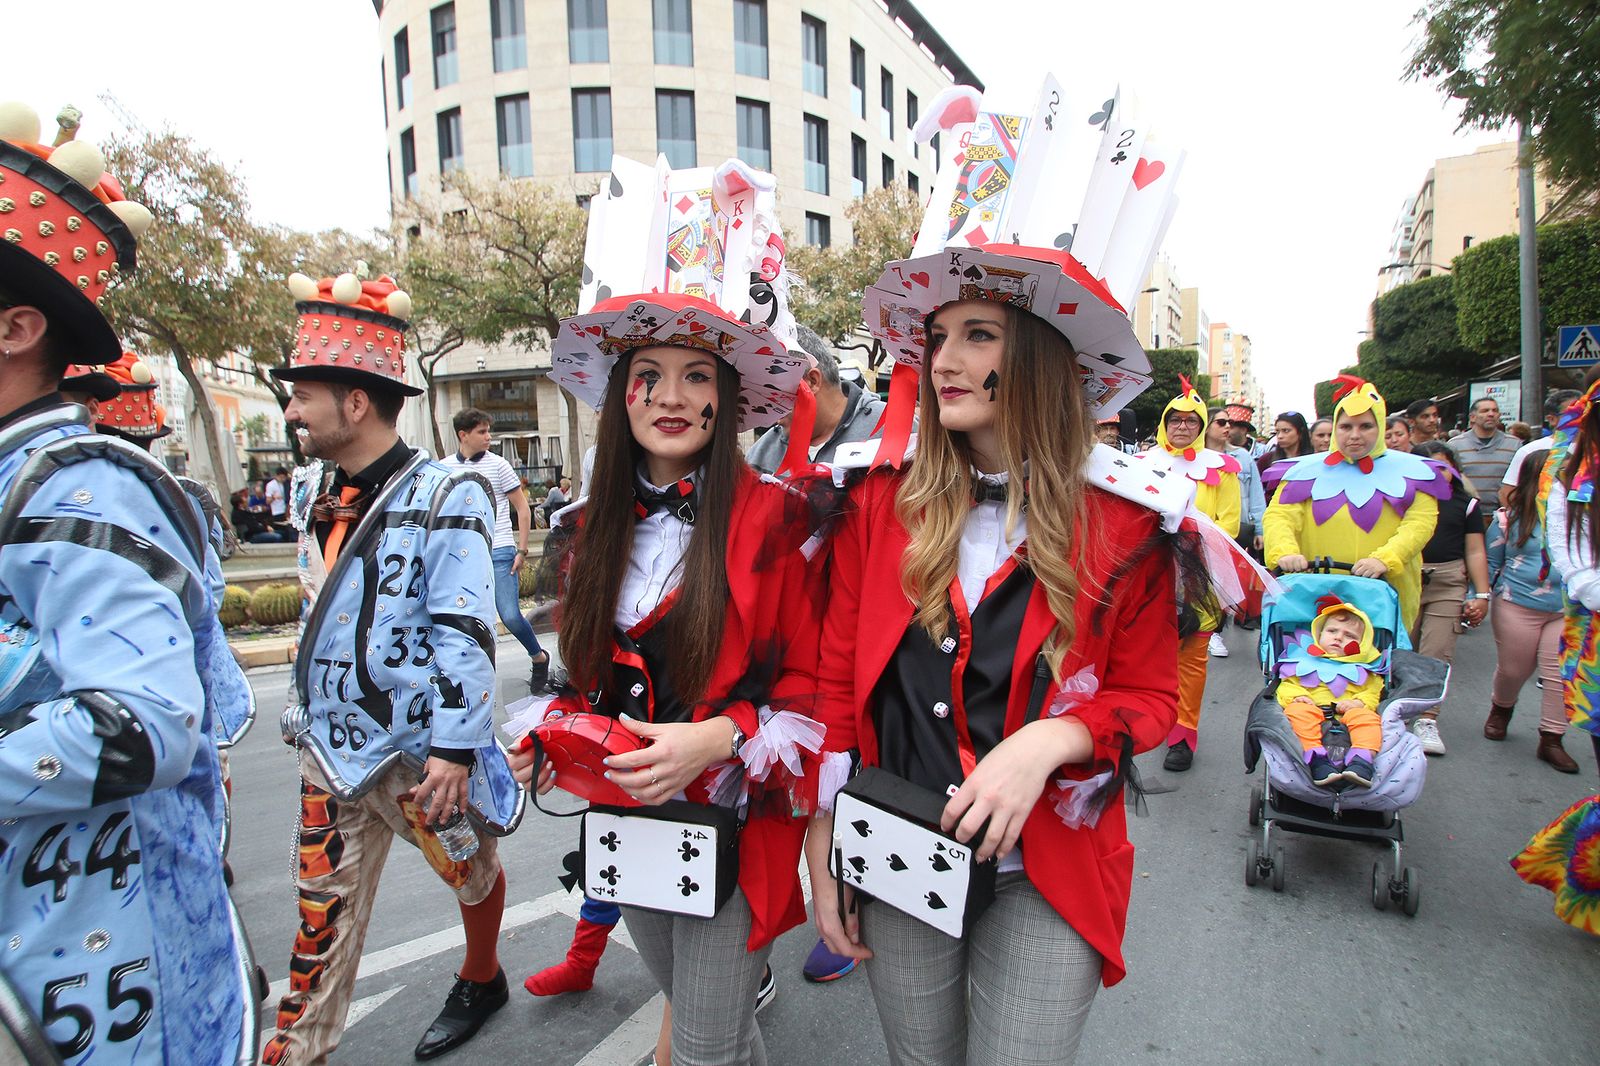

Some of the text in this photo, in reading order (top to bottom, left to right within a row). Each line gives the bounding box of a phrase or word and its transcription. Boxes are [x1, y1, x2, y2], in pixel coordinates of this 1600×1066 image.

[1048, 90, 1060, 116] 2
[959, 131, 972, 148] Q
[1115, 128, 1135, 148] 2
[732, 199, 745, 217] K
[949, 252, 962, 266] K
[891, 267, 904, 281] 7
[634, 305, 645, 316] Q
[684, 311, 697, 321] Q
[569, 322, 581, 332] Q
[557, 356, 573, 364] 5
[378, 553, 427, 599] 22
[383, 626, 436, 669] 33
[314, 658, 354, 703] 77
[328, 711, 368, 752] 66
[693, 830, 709, 841] 4
[22, 811, 141, 902] 44
[948, 848, 966, 862] 5
[591, 886, 606, 896] 4
[42, 956, 154, 1059] 55
